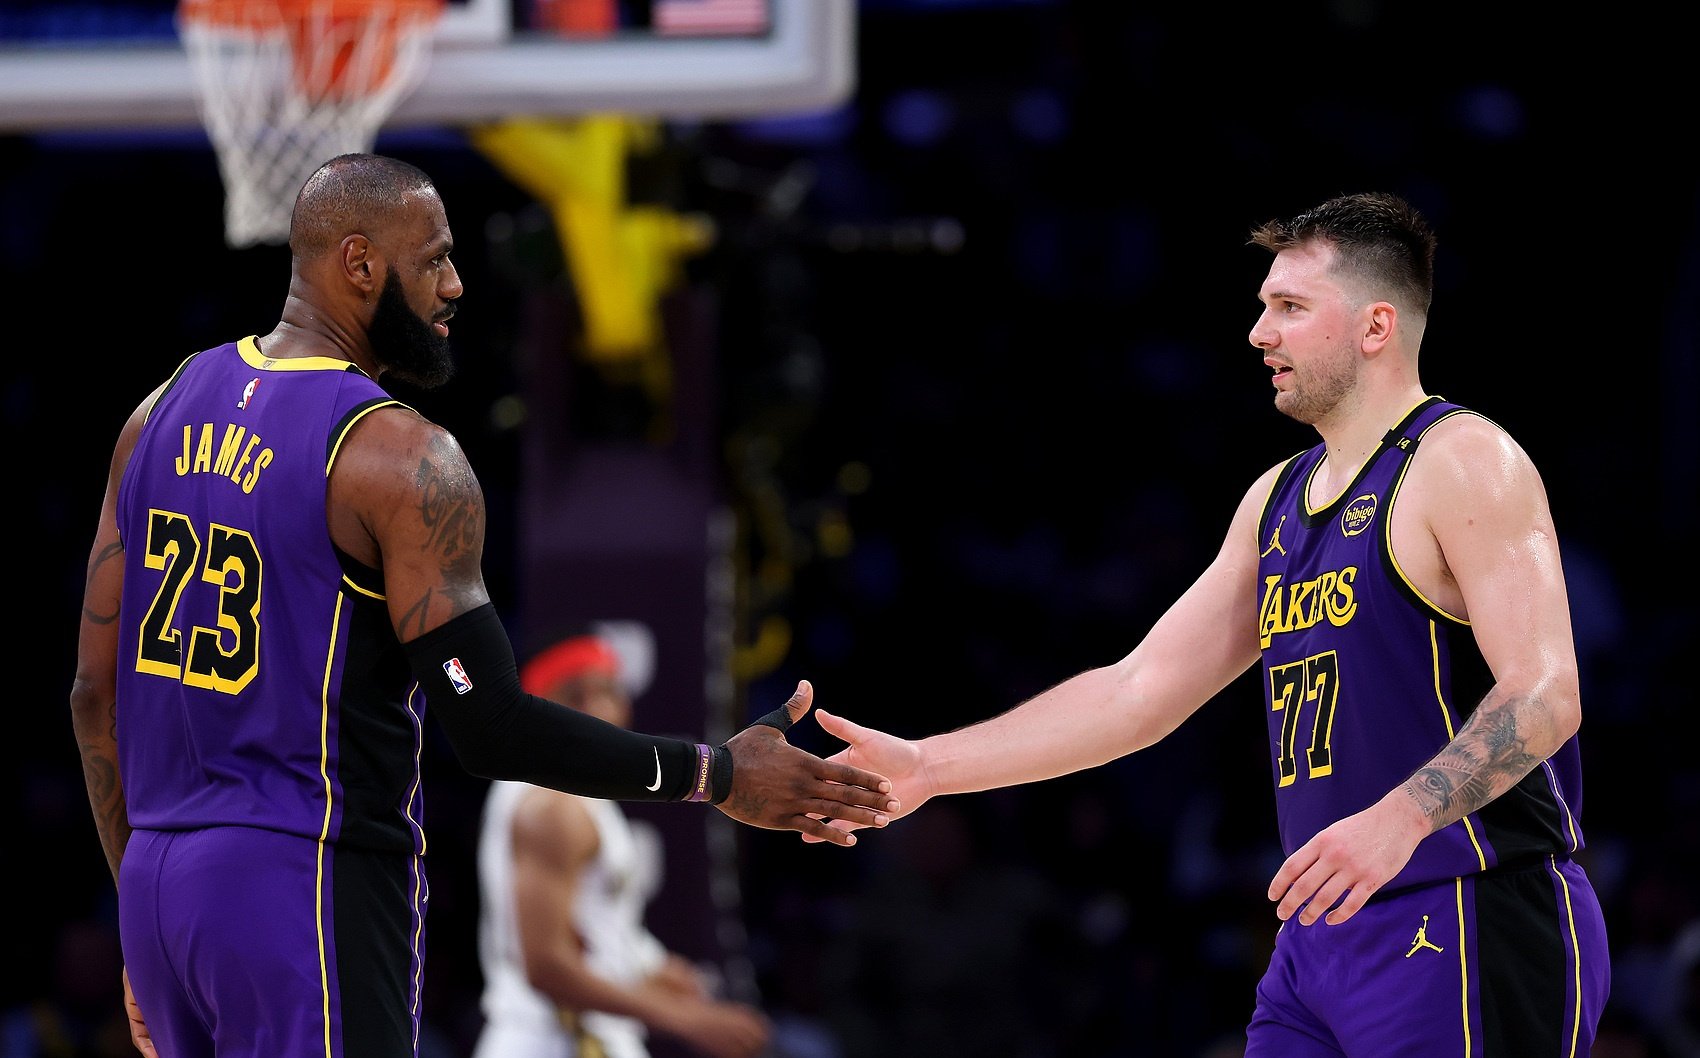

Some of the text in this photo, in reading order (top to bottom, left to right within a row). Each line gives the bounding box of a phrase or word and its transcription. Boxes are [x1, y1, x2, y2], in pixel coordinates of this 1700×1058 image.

[175, 423, 274, 494] JAMES
[1396, 437, 1411, 450] 14
[1345, 505, 1374, 522] bibigo
[136, 508, 263, 695] 23
[1259, 565, 1358, 651] LAKERS
[1268, 649, 1340, 788] 77
[697, 758, 708, 793] PROMISE
